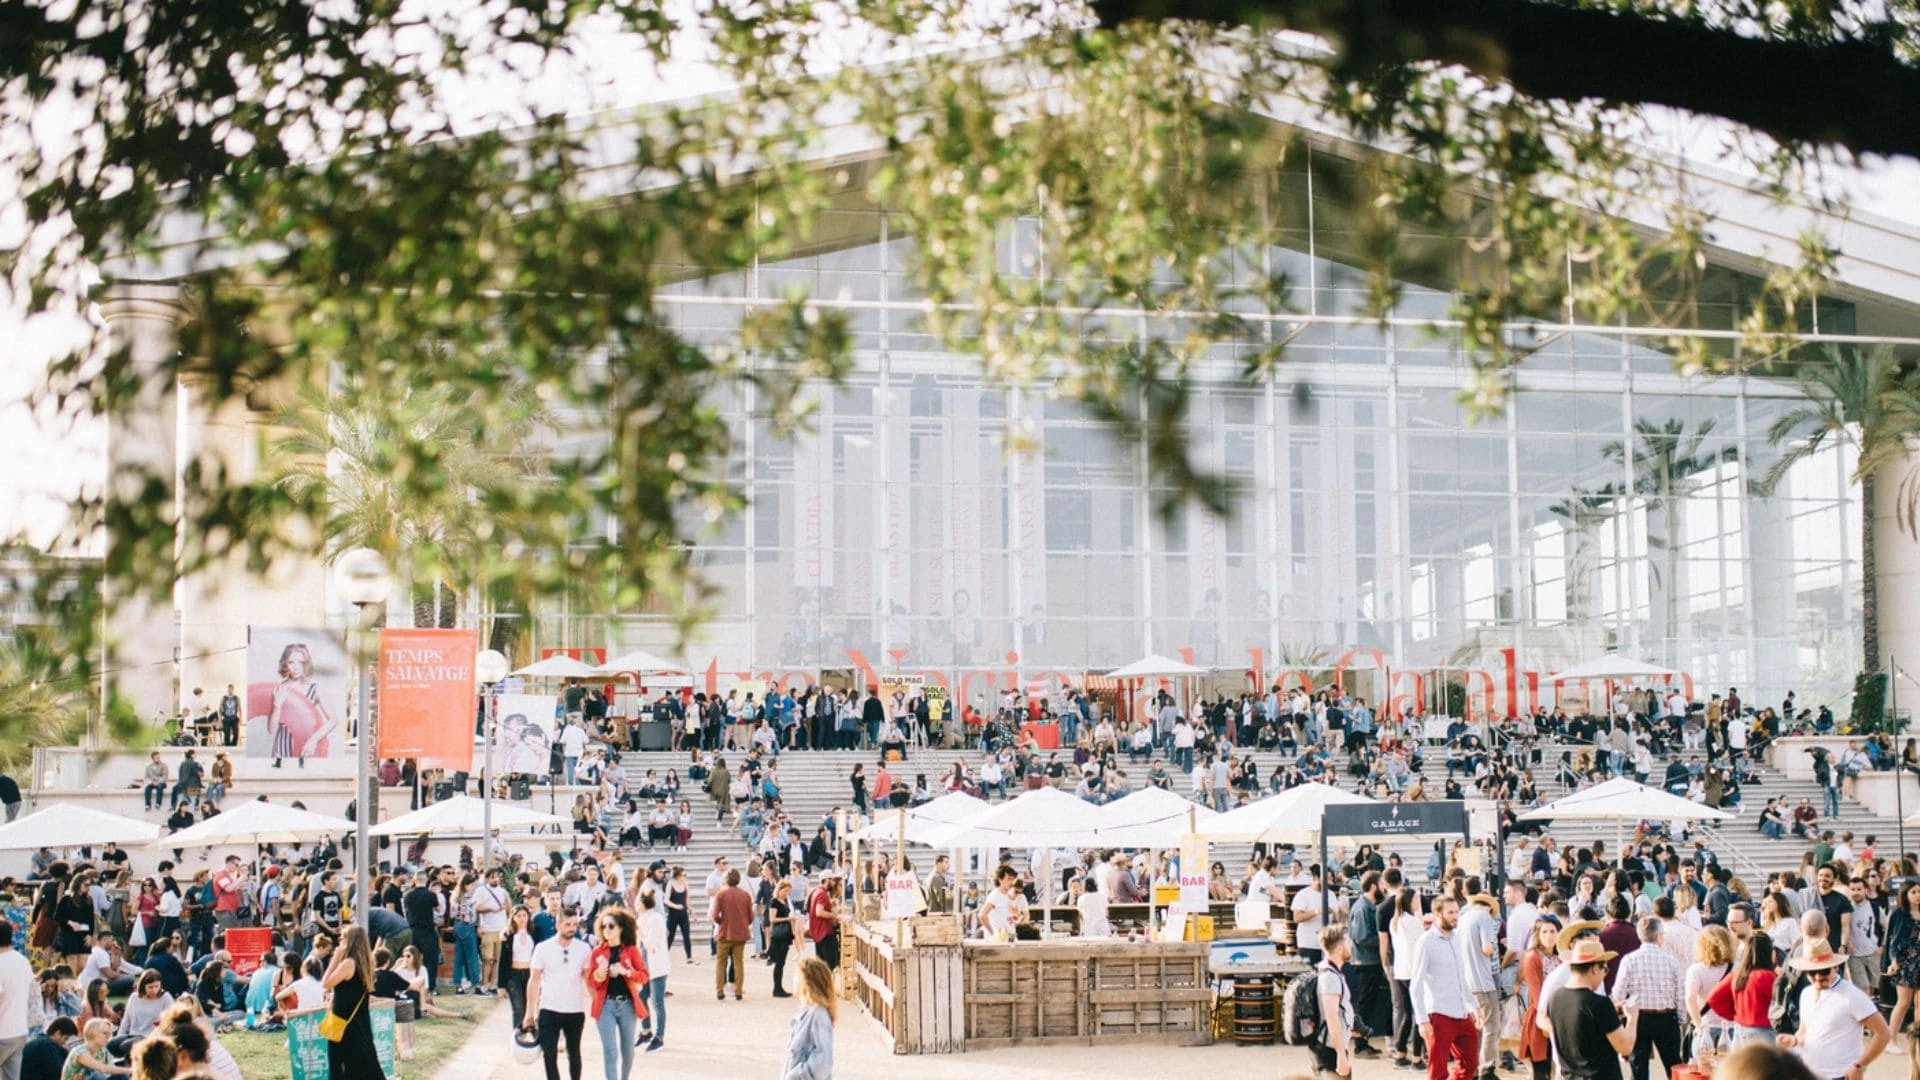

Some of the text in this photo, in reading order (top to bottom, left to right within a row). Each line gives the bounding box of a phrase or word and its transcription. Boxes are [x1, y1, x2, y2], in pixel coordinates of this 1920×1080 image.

[385, 648, 444, 664] TEMPS
[385, 666, 469, 681] SALVATGE
[1371, 819, 1420, 828] GARAGE
[889, 879, 913, 890] BAR
[1182, 876, 1206, 886] BAR
